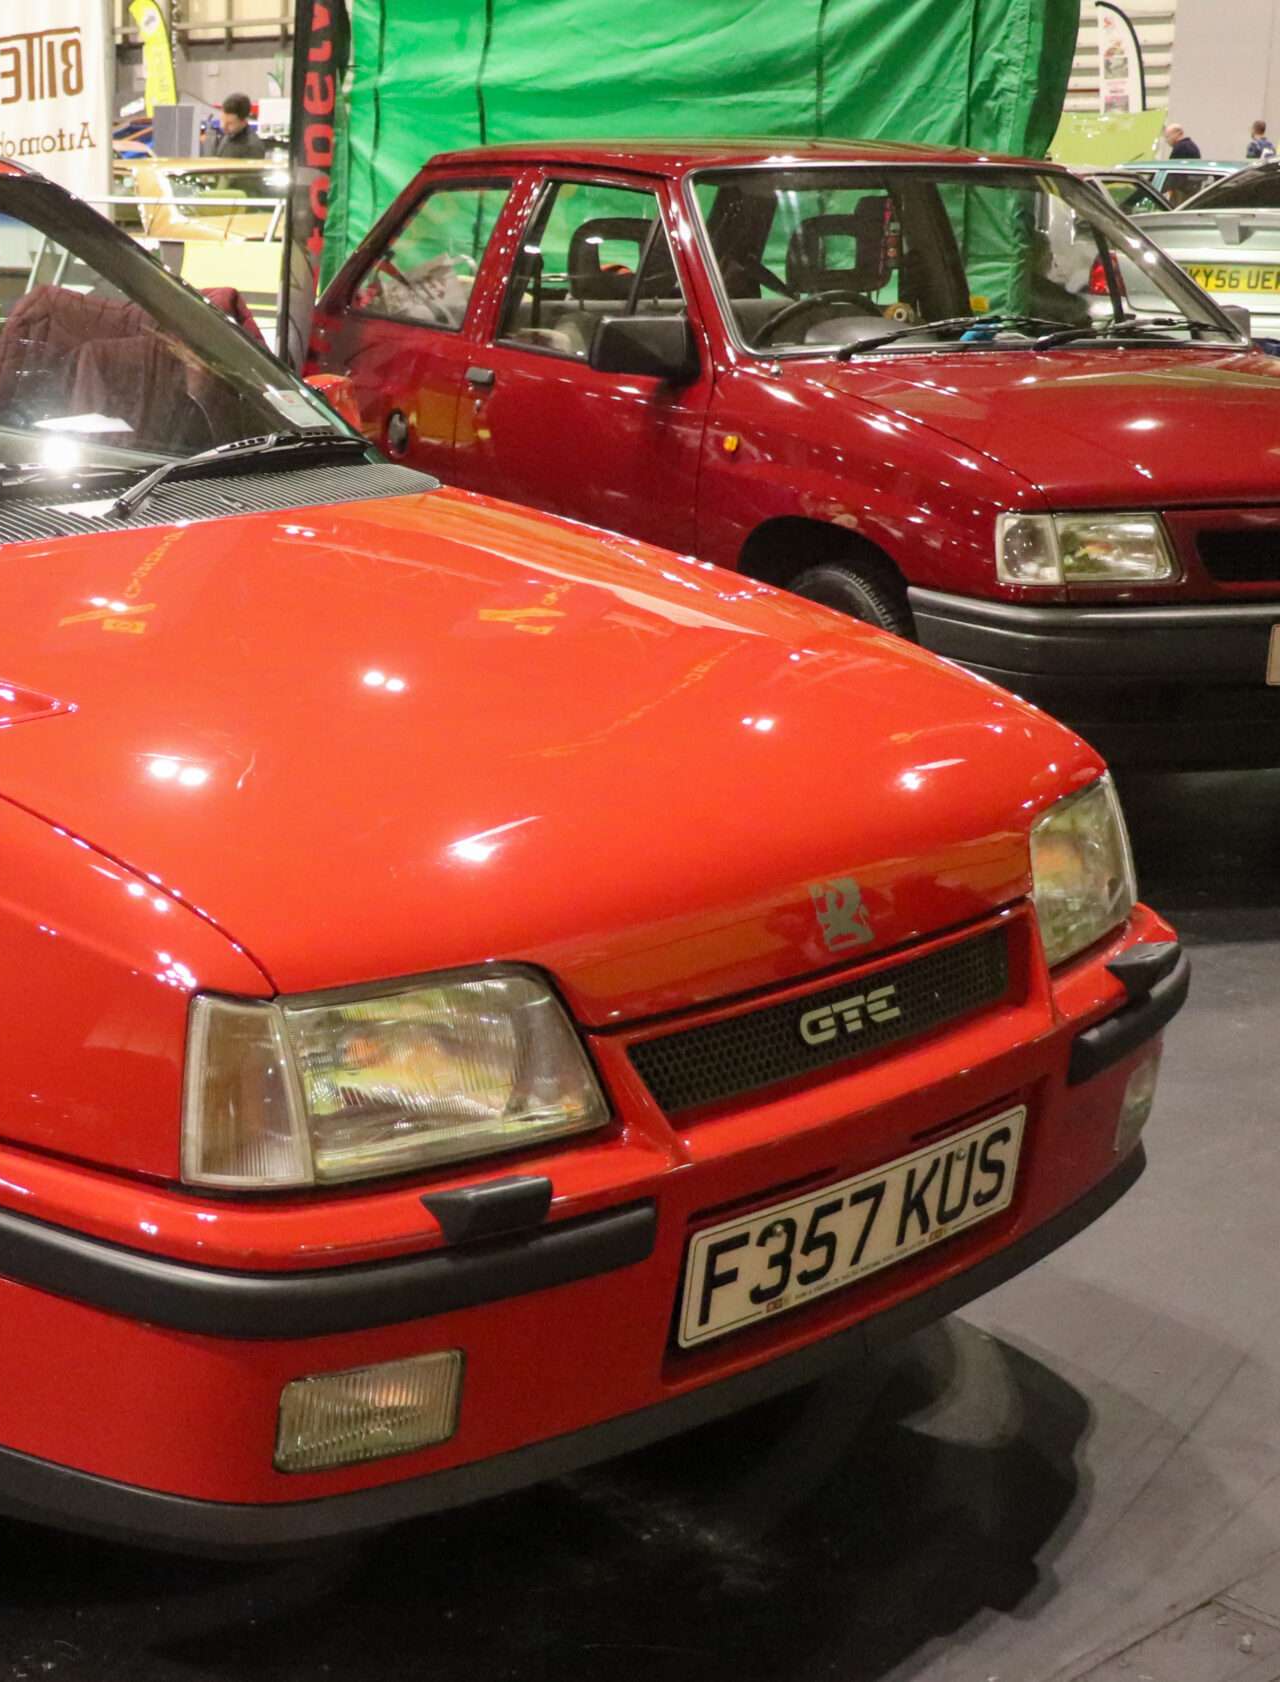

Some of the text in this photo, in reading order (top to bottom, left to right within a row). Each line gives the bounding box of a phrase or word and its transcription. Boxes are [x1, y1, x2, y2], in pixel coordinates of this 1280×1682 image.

[1188, 268, 1240, 289] KY56
[800, 985, 901, 1045] GTE
[698, 1181, 886, 1326] F357
[896, 1126, 1011, 1246] KUS
